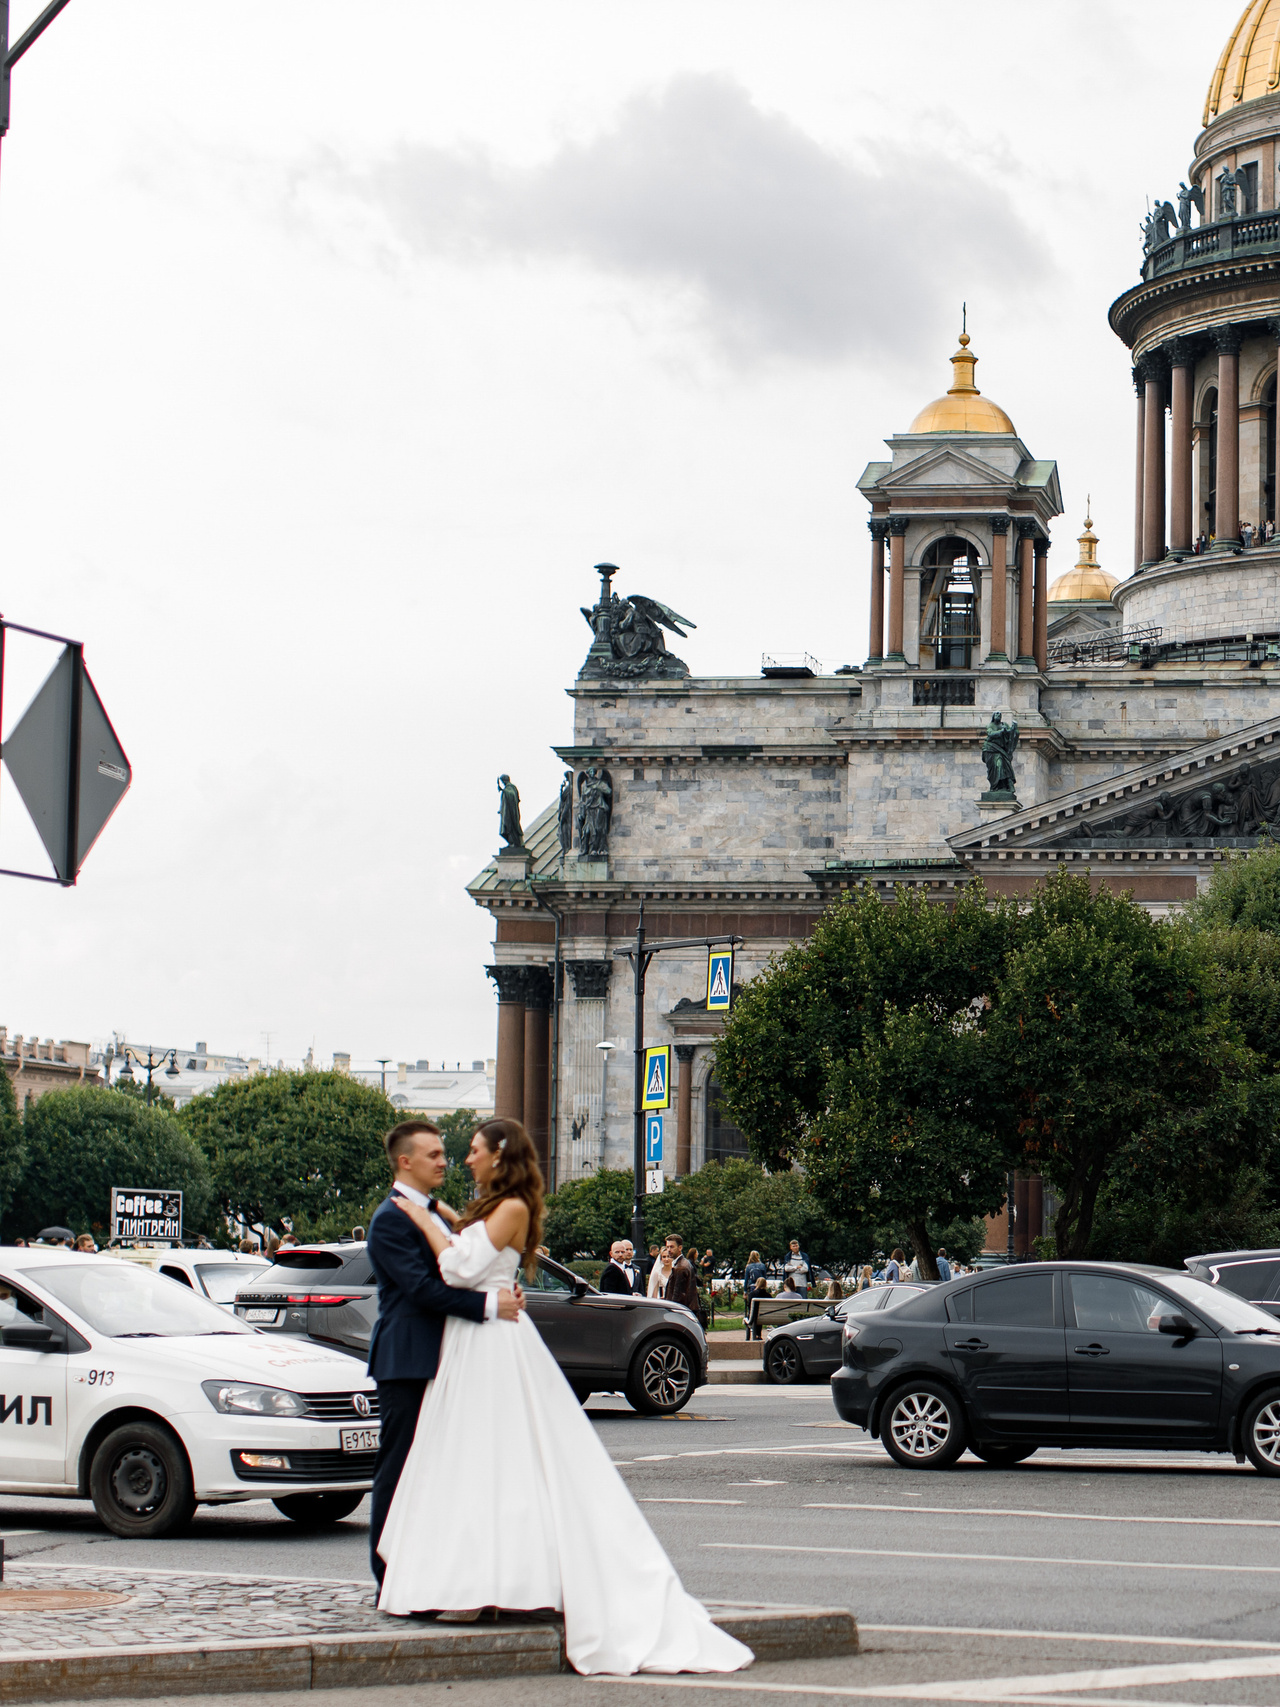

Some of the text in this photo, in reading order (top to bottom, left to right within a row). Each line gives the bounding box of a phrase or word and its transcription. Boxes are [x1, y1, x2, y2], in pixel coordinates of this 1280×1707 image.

[650, 1121, 660, 1157] P
[116, 1195, 163, 1217] Coffee
[88, 1369, 115, 1386] 913
